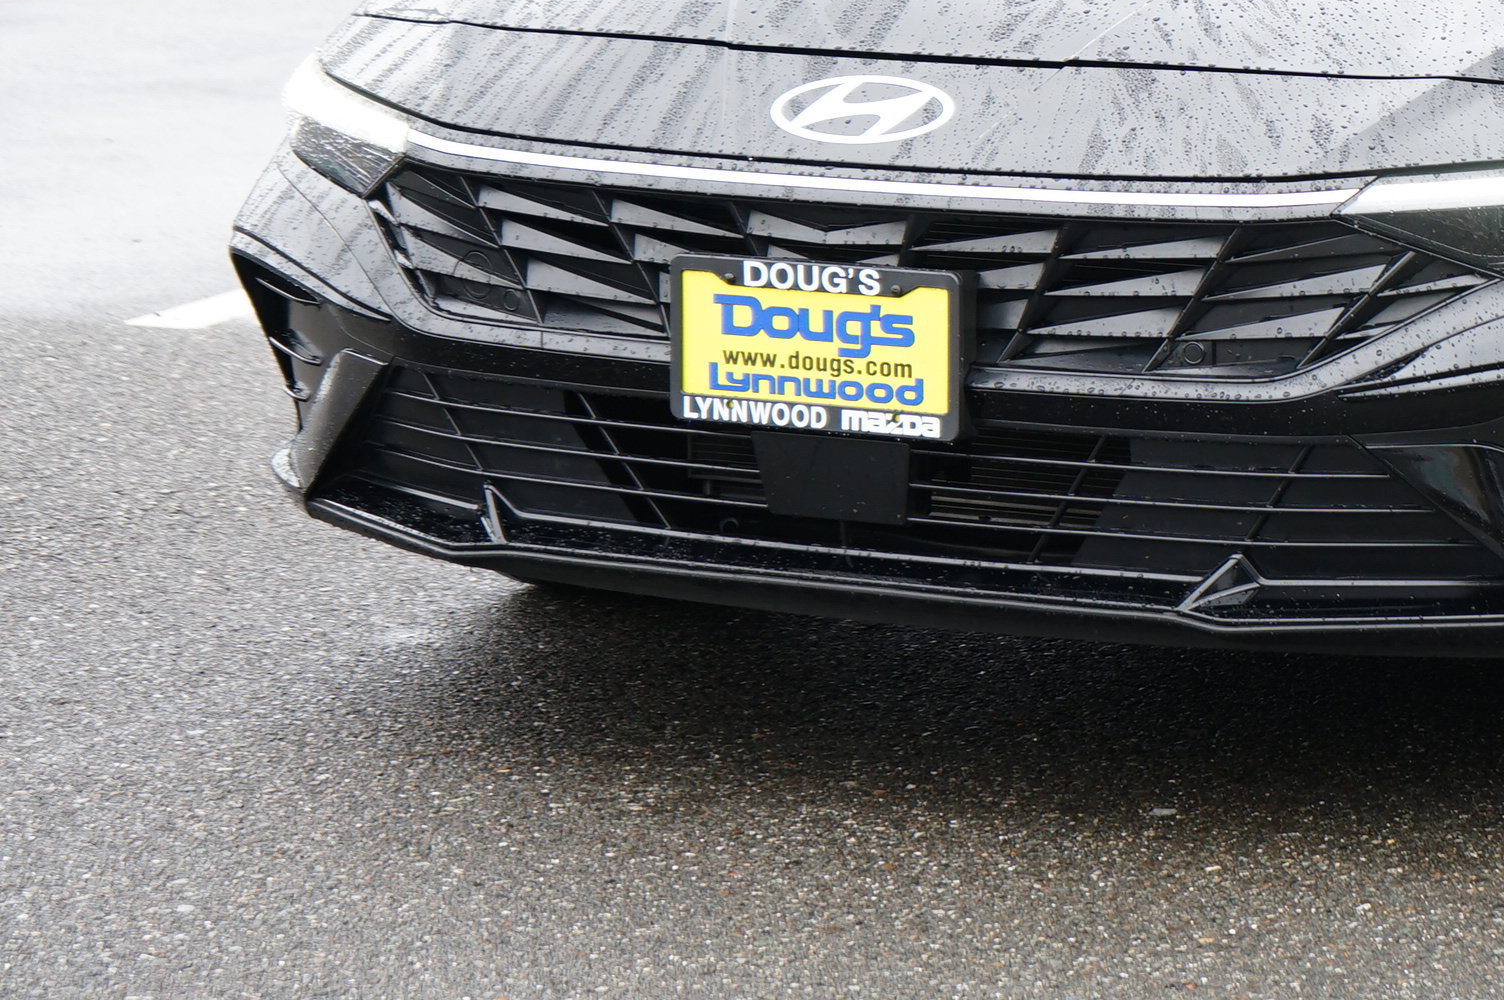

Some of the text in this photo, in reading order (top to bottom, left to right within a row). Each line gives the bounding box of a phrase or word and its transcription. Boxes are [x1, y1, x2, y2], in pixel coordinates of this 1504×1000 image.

[743, 261, 880, 295] DOUG'S
[713, 293, 915, 358] Doug's
[709, 362, 923, 406] Lynnwood
[723, 350, 912, 377] www.dougs.com
[682, 396, 940, 438] LYNNWOOD mazda
